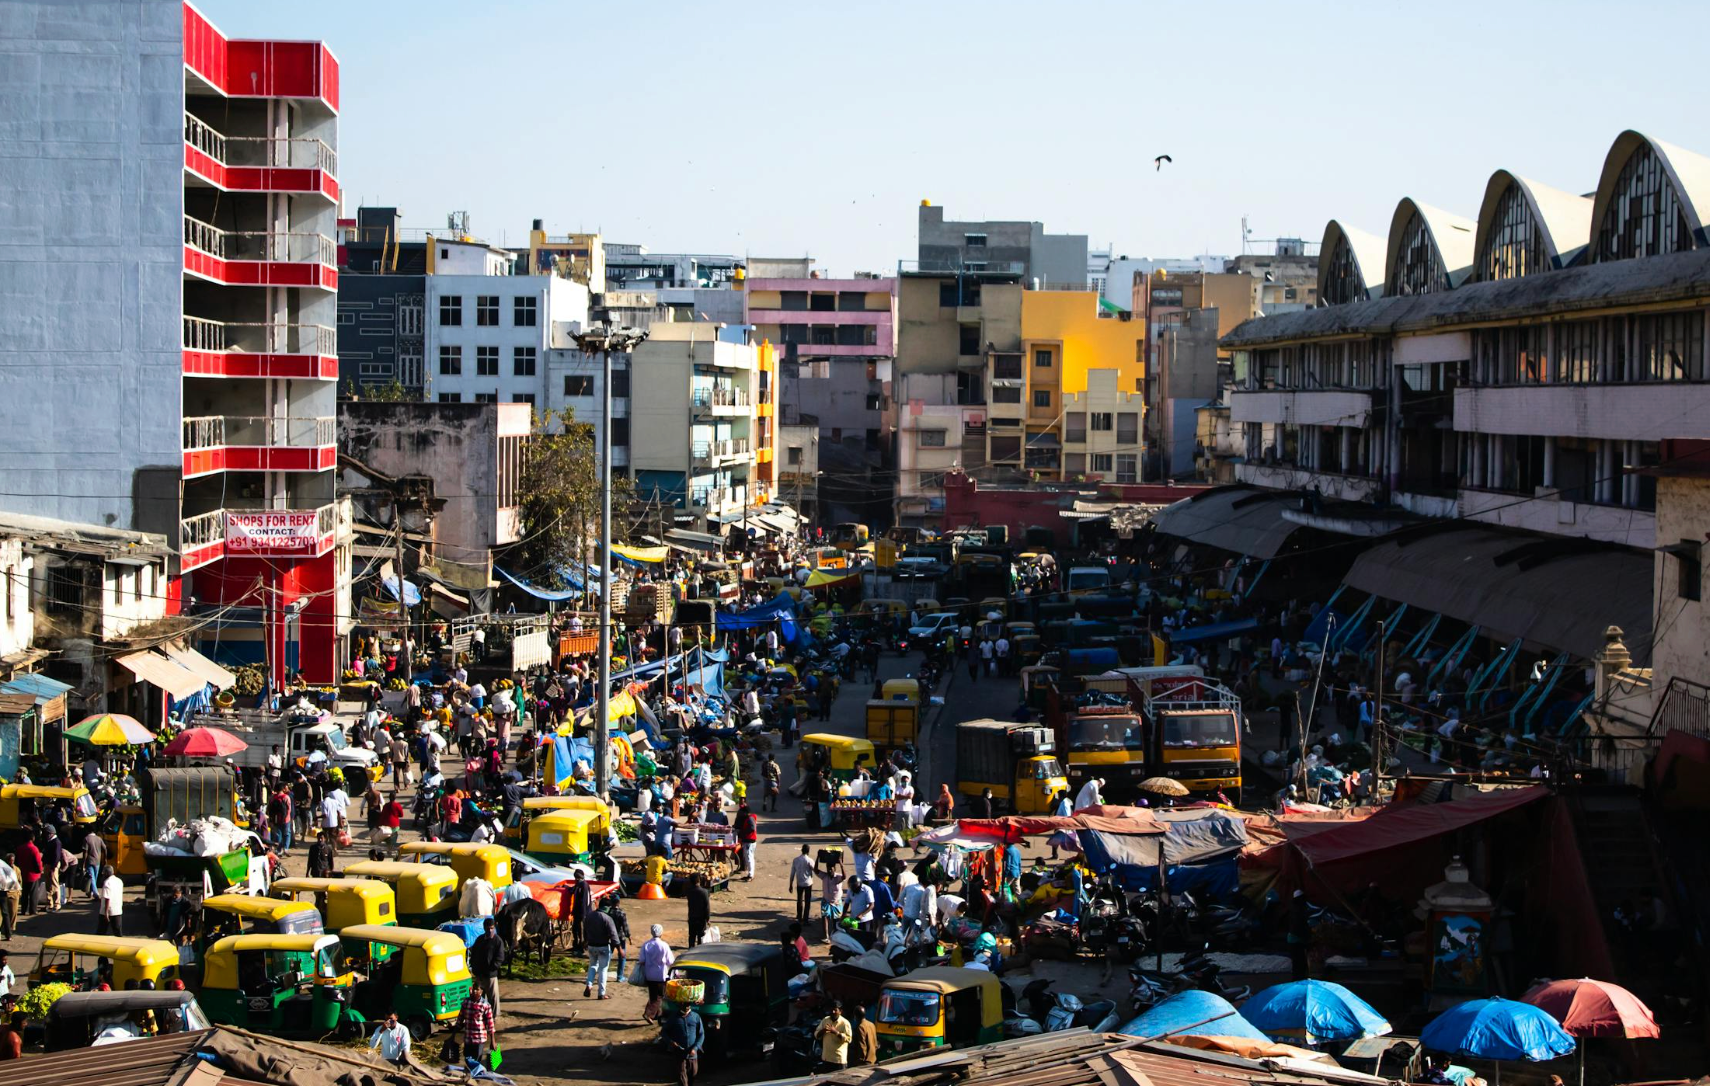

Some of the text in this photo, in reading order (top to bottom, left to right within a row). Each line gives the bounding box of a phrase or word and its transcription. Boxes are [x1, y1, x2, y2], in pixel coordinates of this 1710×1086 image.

[229, 514, 315, 526] SHOPS FOR RENT
[229, 537, 247, 547] +91
